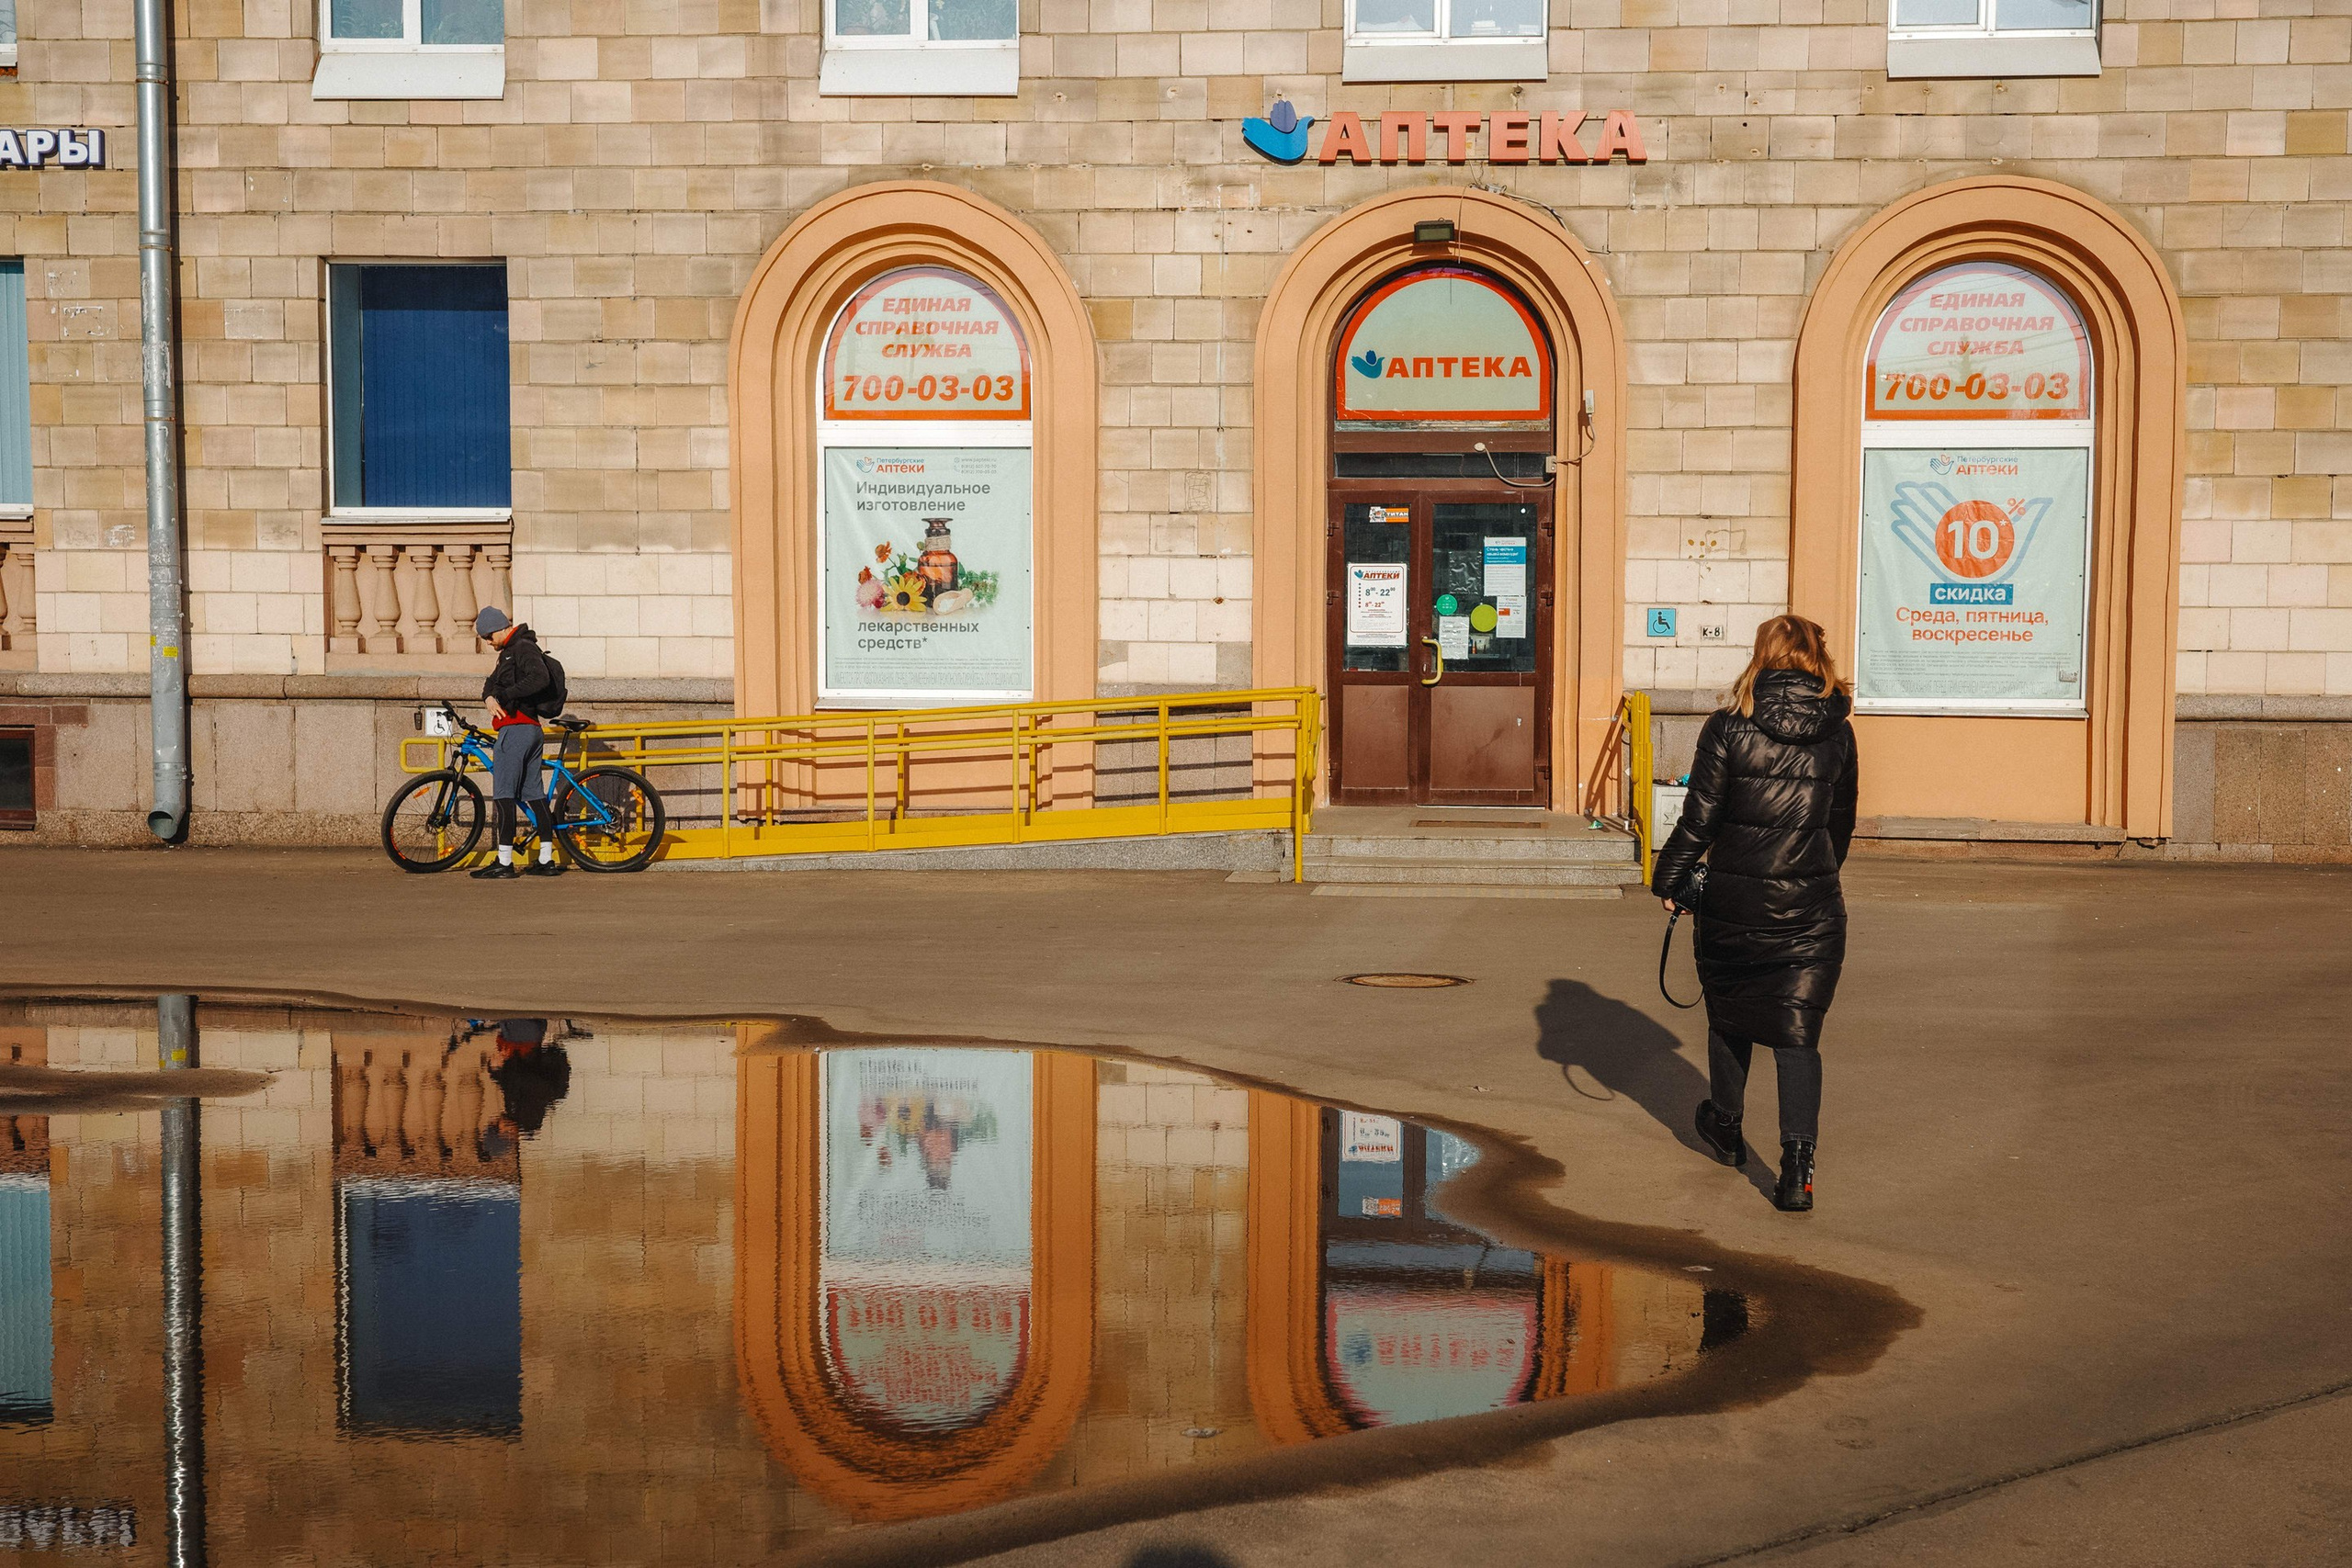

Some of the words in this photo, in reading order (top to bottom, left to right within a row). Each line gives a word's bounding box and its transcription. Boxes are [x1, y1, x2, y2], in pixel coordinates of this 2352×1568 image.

[1318, 110, 1647, 164] АПТЕКА
[882, 298, 971, 314] ЕДИНАЯ
[1930, 293, 2025, 310] ЕДИНАЯ
[855, 321, 999, 335] СПРАВОЧНАЯ
[1899, 317, 2054, 332] СПРАВОЧНАЯ
[882, 344, 972, 358] СЛУЖБА
[1927, 341, 2024, 355] СЛУЖБА
[1385, 356, 1532, 378] АПТЕКА
[842, 375, 1014, 401] 700-03-03
[1883, 372, 2071, 400] 700-03-03
[856, 481, 990, 497] Индивидуальное
[856, 501, 966, 511] изготовление
[1896, 607, 1960, 626] Среда,
[1965, 610, 2049, 626] пятница,
[857, 622, 979, 636] лекарственных
[1912, 628, 2033, 645] воскресенье
